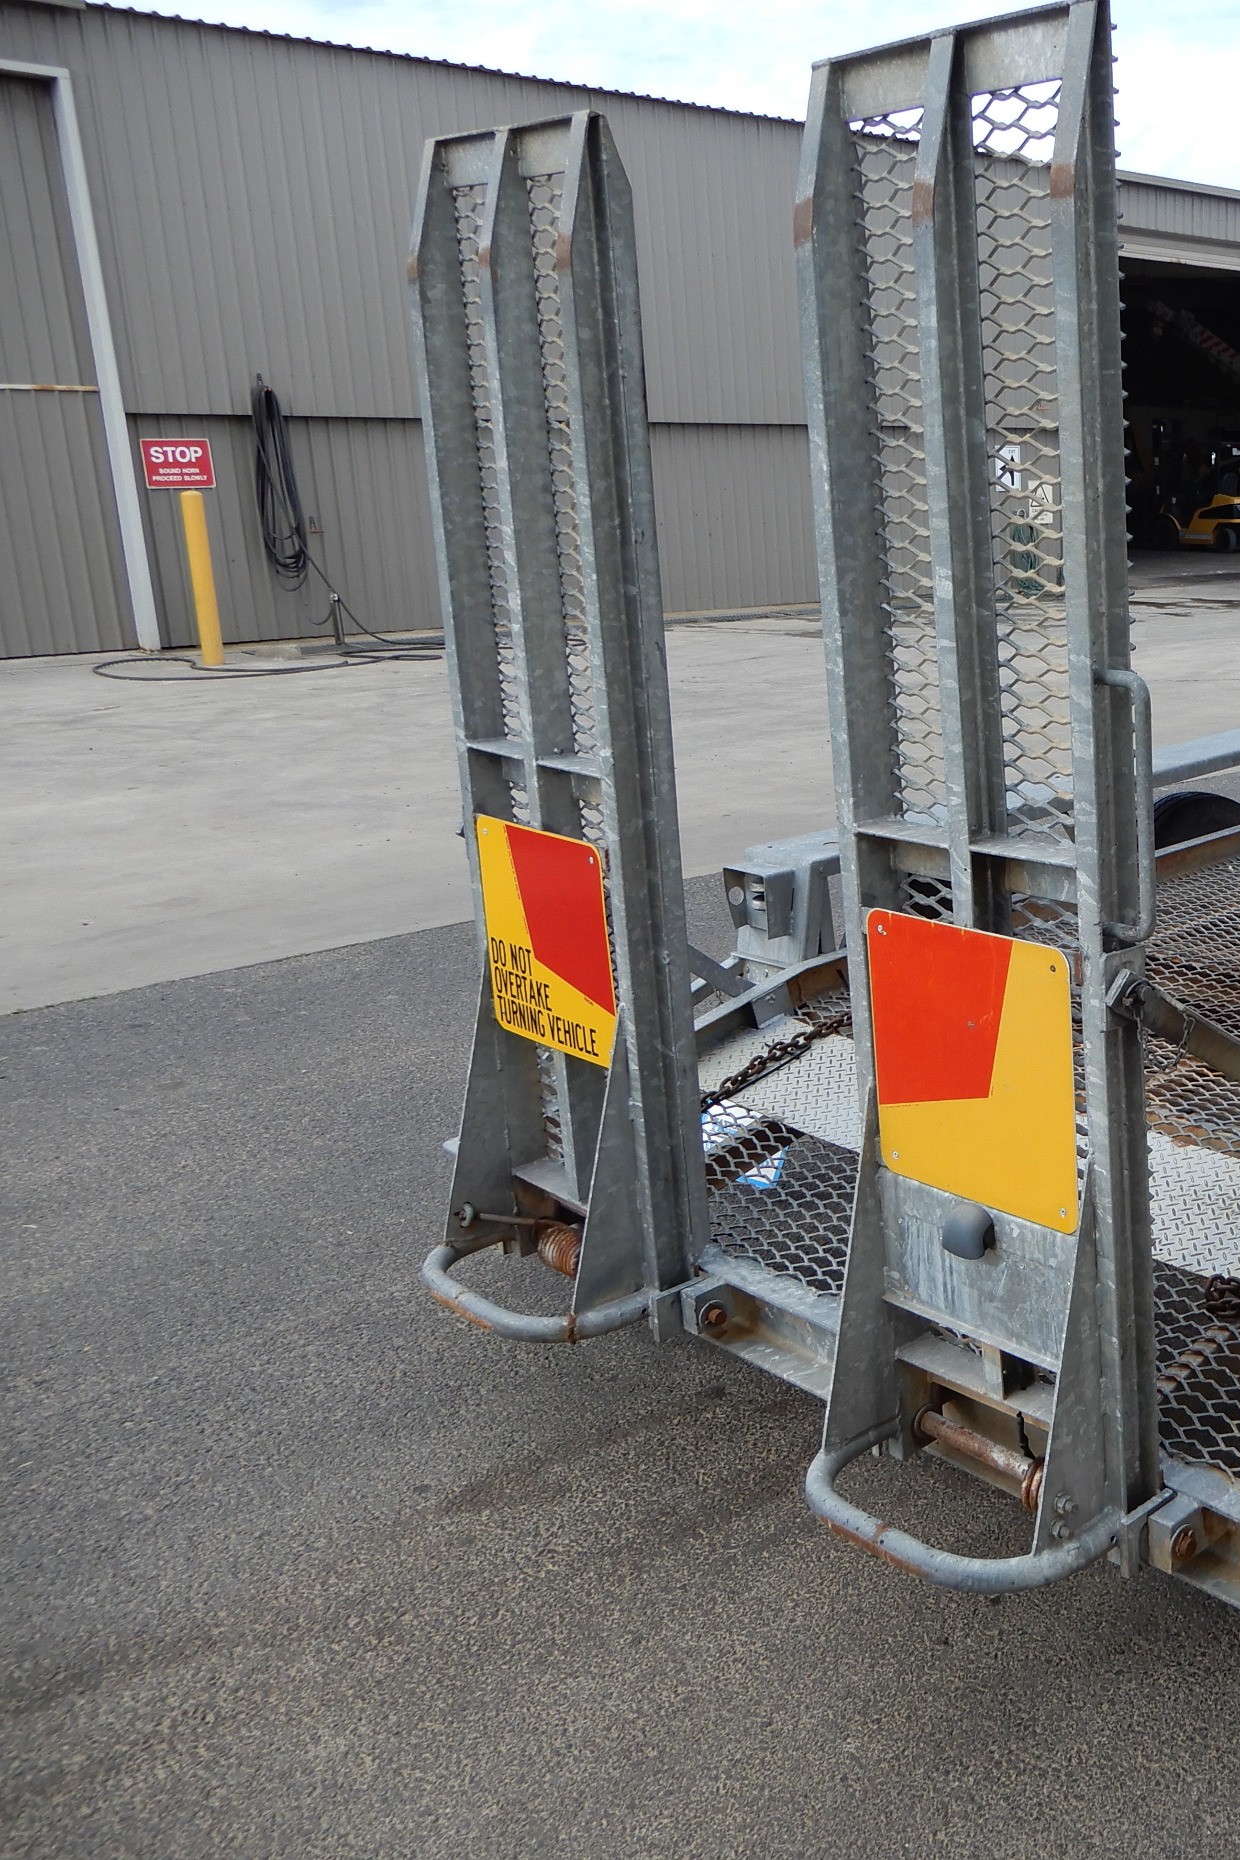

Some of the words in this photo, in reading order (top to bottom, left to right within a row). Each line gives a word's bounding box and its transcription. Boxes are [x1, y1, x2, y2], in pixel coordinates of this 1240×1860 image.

[150, 447, 203, 463] STOP
[490, 937, 507, 967] DO
[510, 943, 533, 976] NOT
[494, 967, 552, 1012] OVERTAKE
[497, 994, 545, 1039] TURNING
[547, 1013, 599, 1057] VEHICLE
